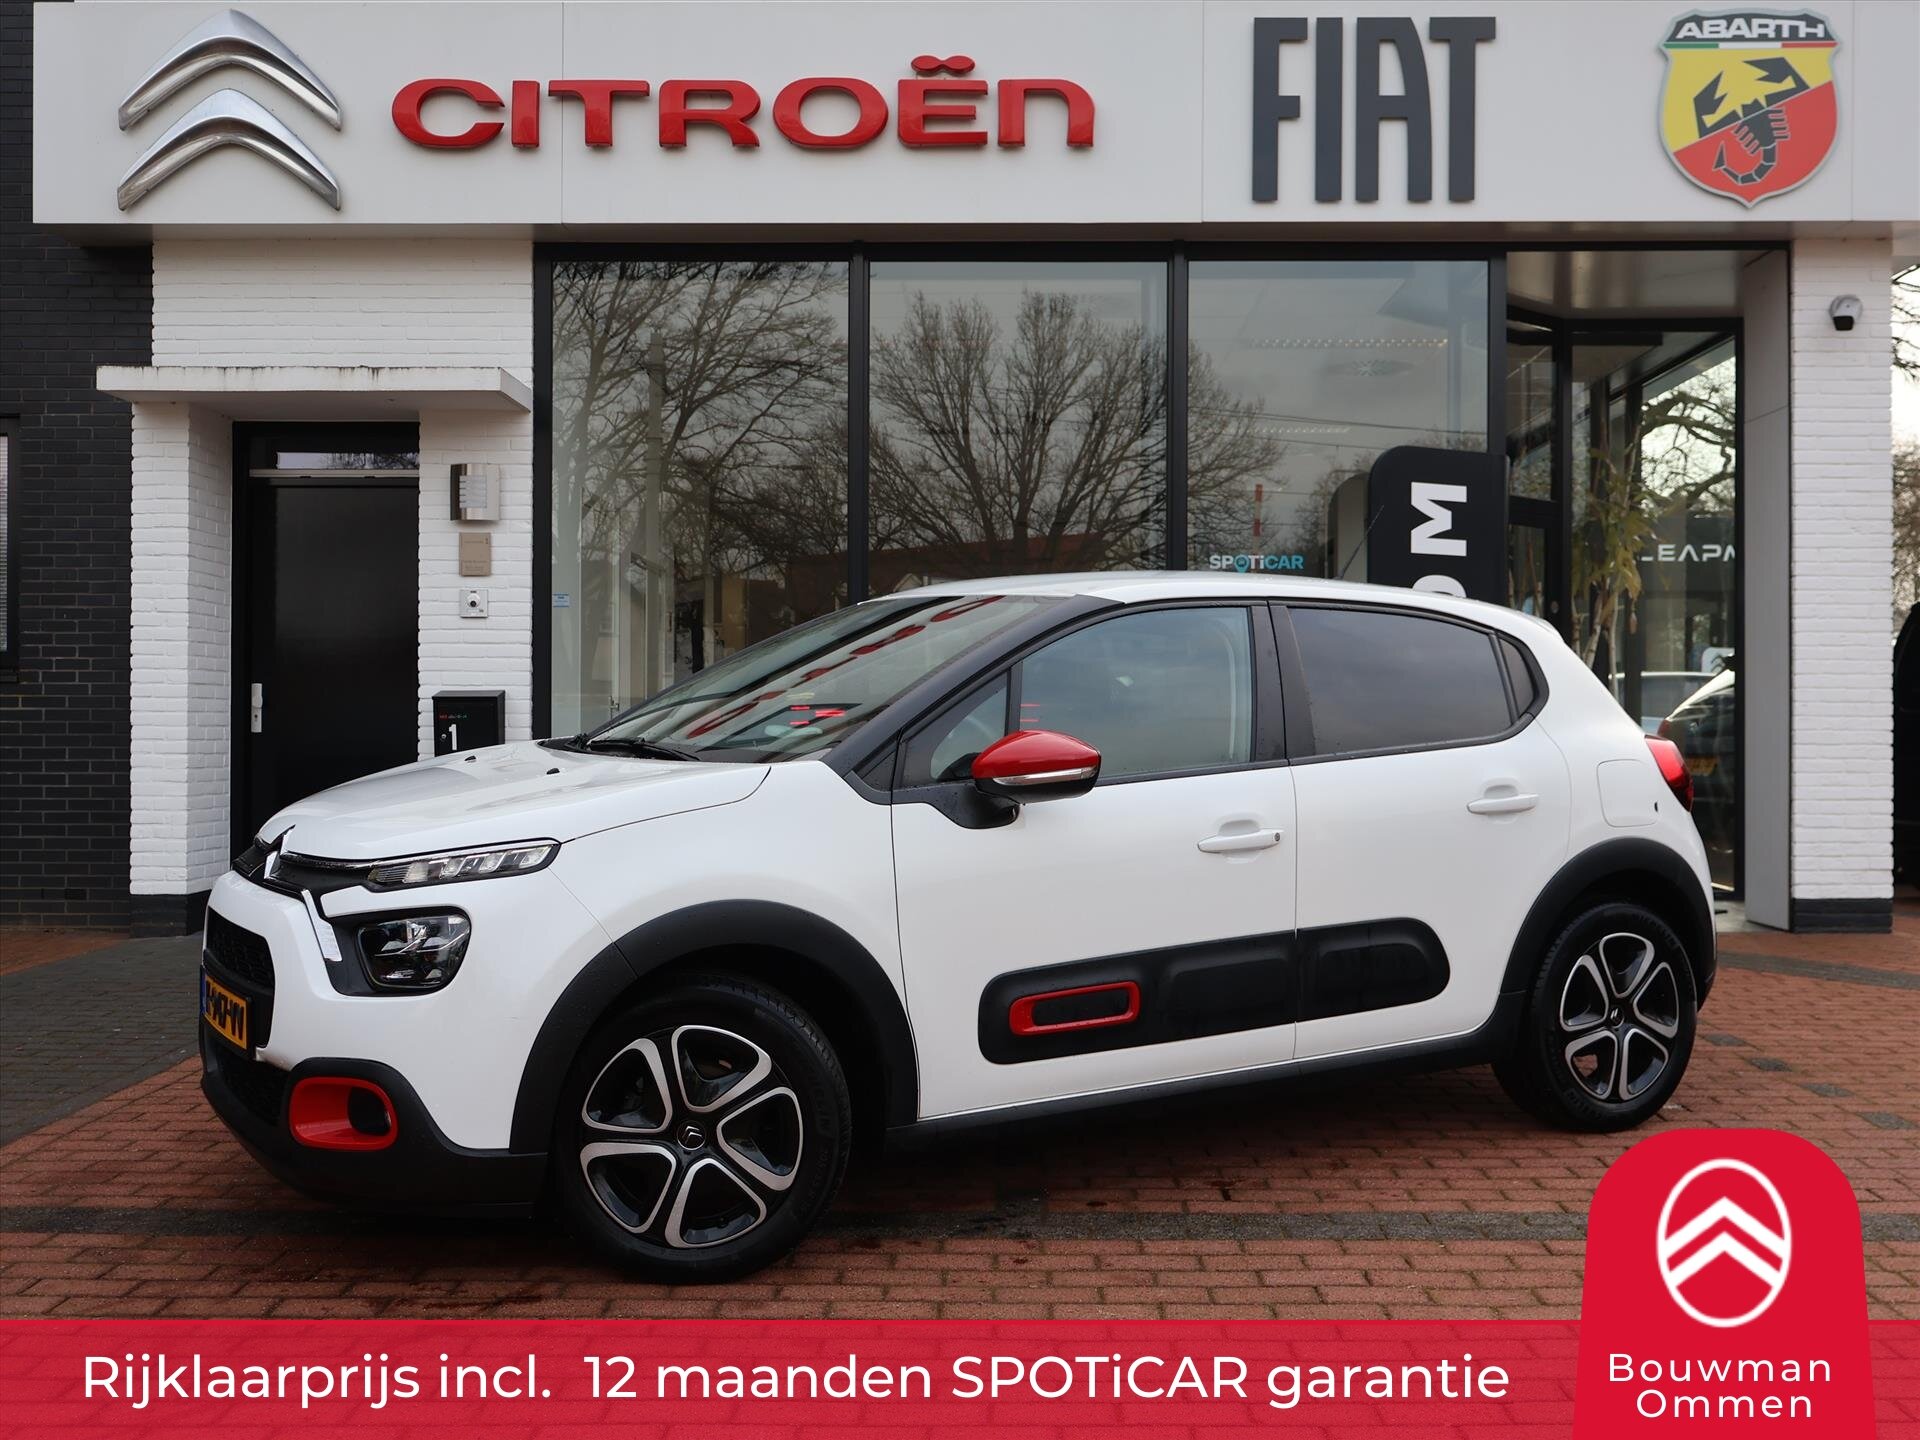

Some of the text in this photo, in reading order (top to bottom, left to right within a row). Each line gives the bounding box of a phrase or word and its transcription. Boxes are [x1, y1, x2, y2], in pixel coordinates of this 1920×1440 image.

[1676, 18, 1825, 39] ABARTH
[391, 55, 1096, 148] CITROËN
[1252, 16, 1496, 204] FIAT
[448, 724, 458, 751] 1
